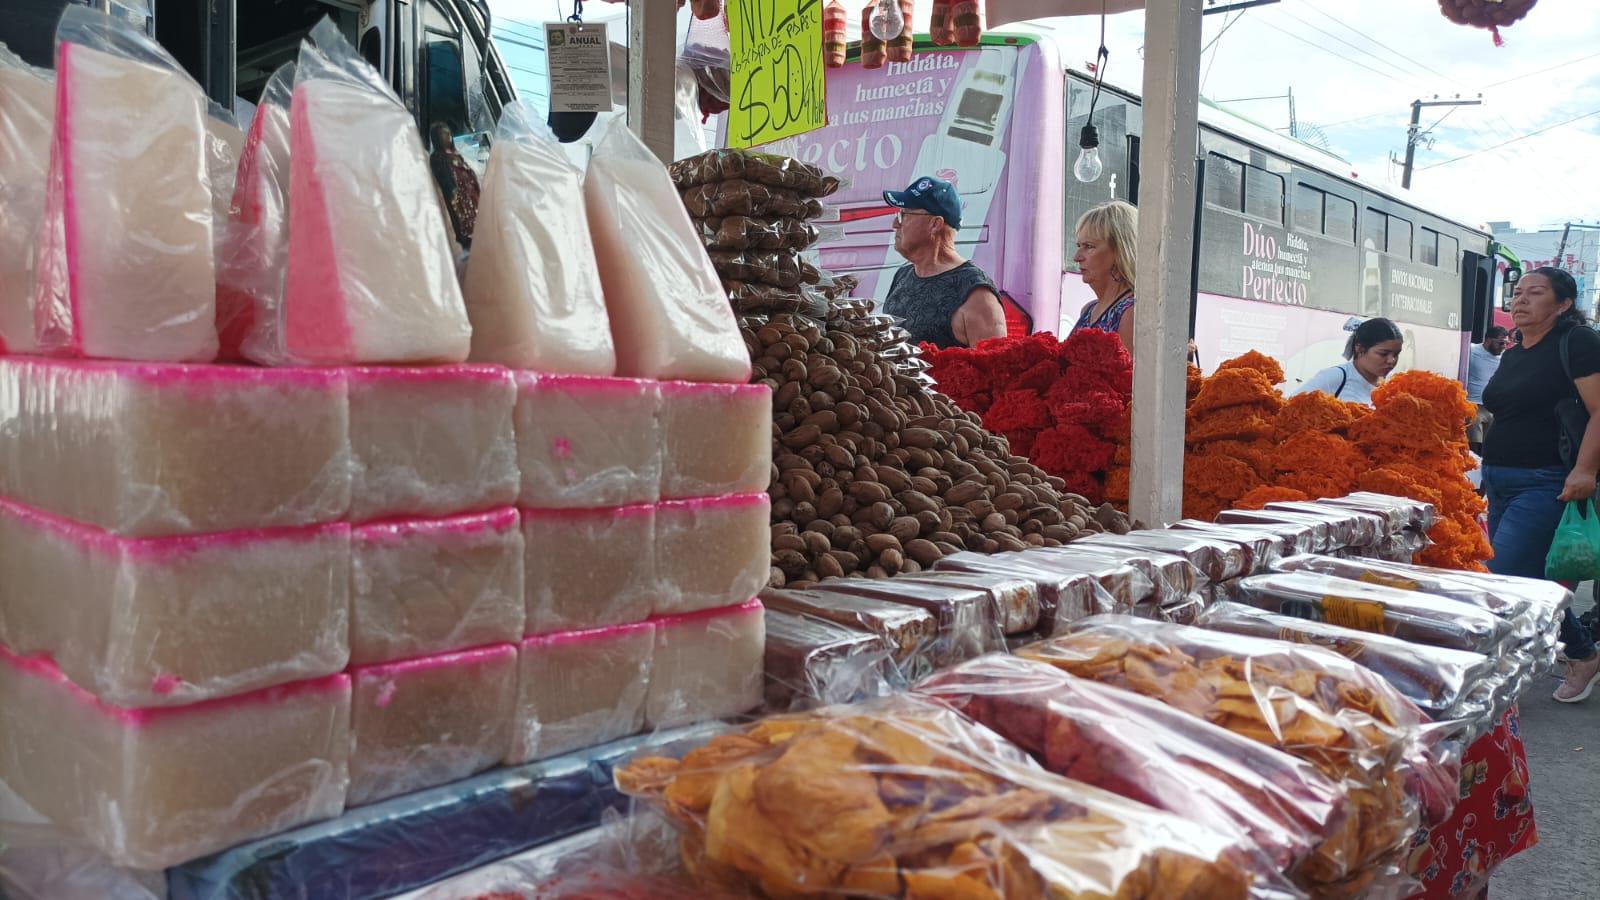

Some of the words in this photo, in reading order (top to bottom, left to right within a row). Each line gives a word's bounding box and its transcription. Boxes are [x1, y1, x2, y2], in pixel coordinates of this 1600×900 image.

[569, 36, 601, 45] ANUAL
[855, 77, 934, 102] humecta
[937, 77, 952, 97] y
[843, 110, 869, 126] tus
[871, 97, 945, 123] manchas
[1243, 222, 1276, 260] Dúo
[1242, 265, 1307, 306] Perfecto
[1285, 265, 1311, 281] manchas
